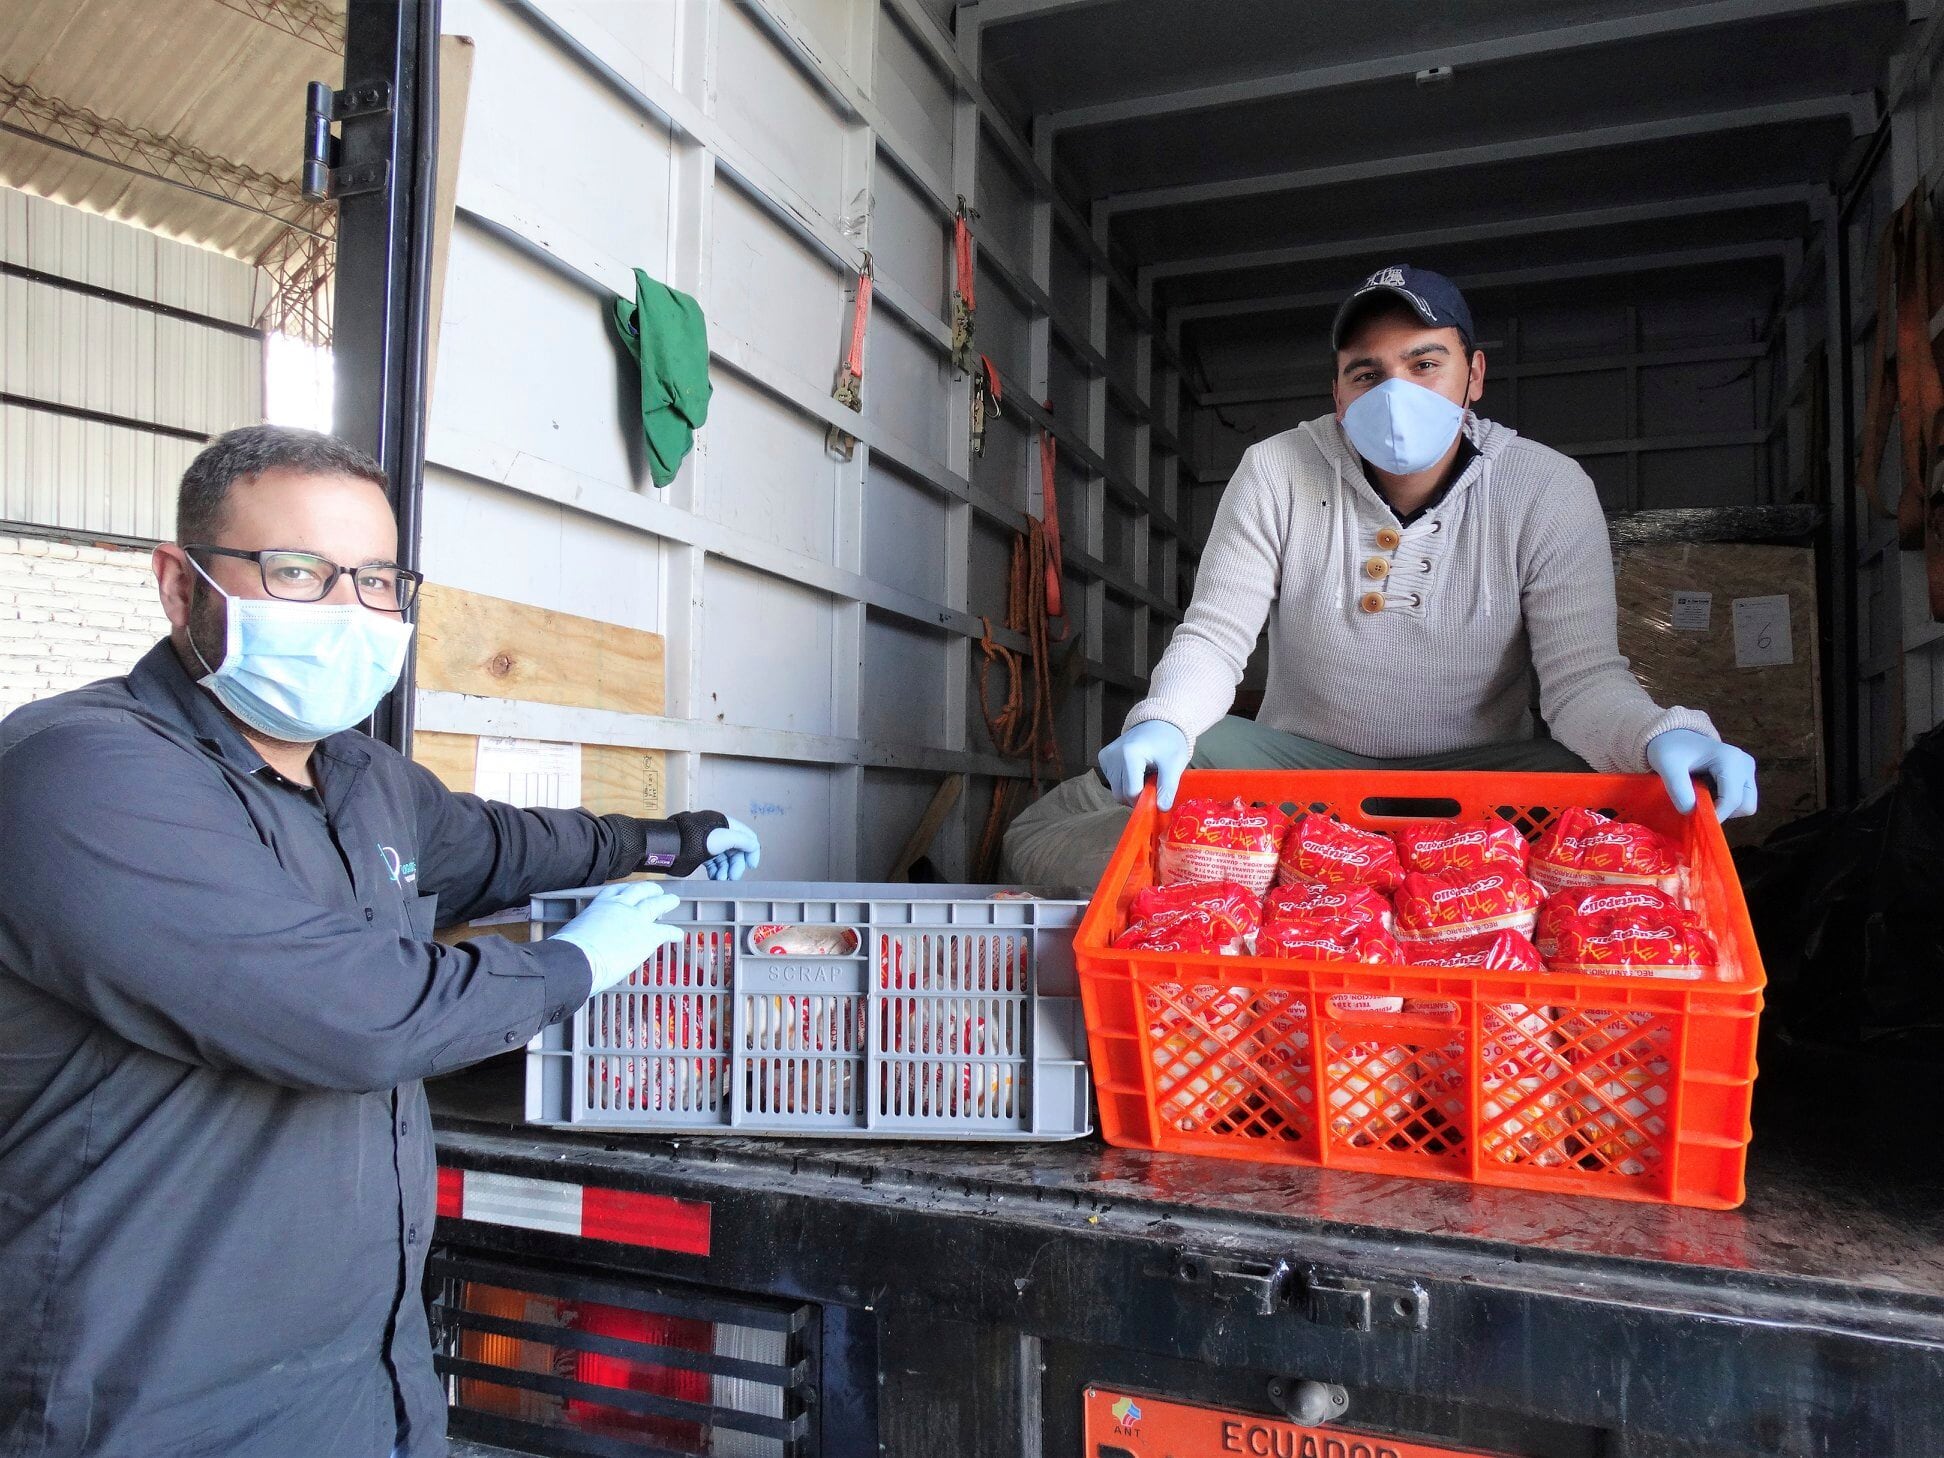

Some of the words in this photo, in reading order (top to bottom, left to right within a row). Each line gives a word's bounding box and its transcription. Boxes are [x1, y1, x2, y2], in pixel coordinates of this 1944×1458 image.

[1758, 621, 1771, 649] 6
[768, 965, 843, 982] SCRAP
[1114, 1425, 1140, 1438] ANT
